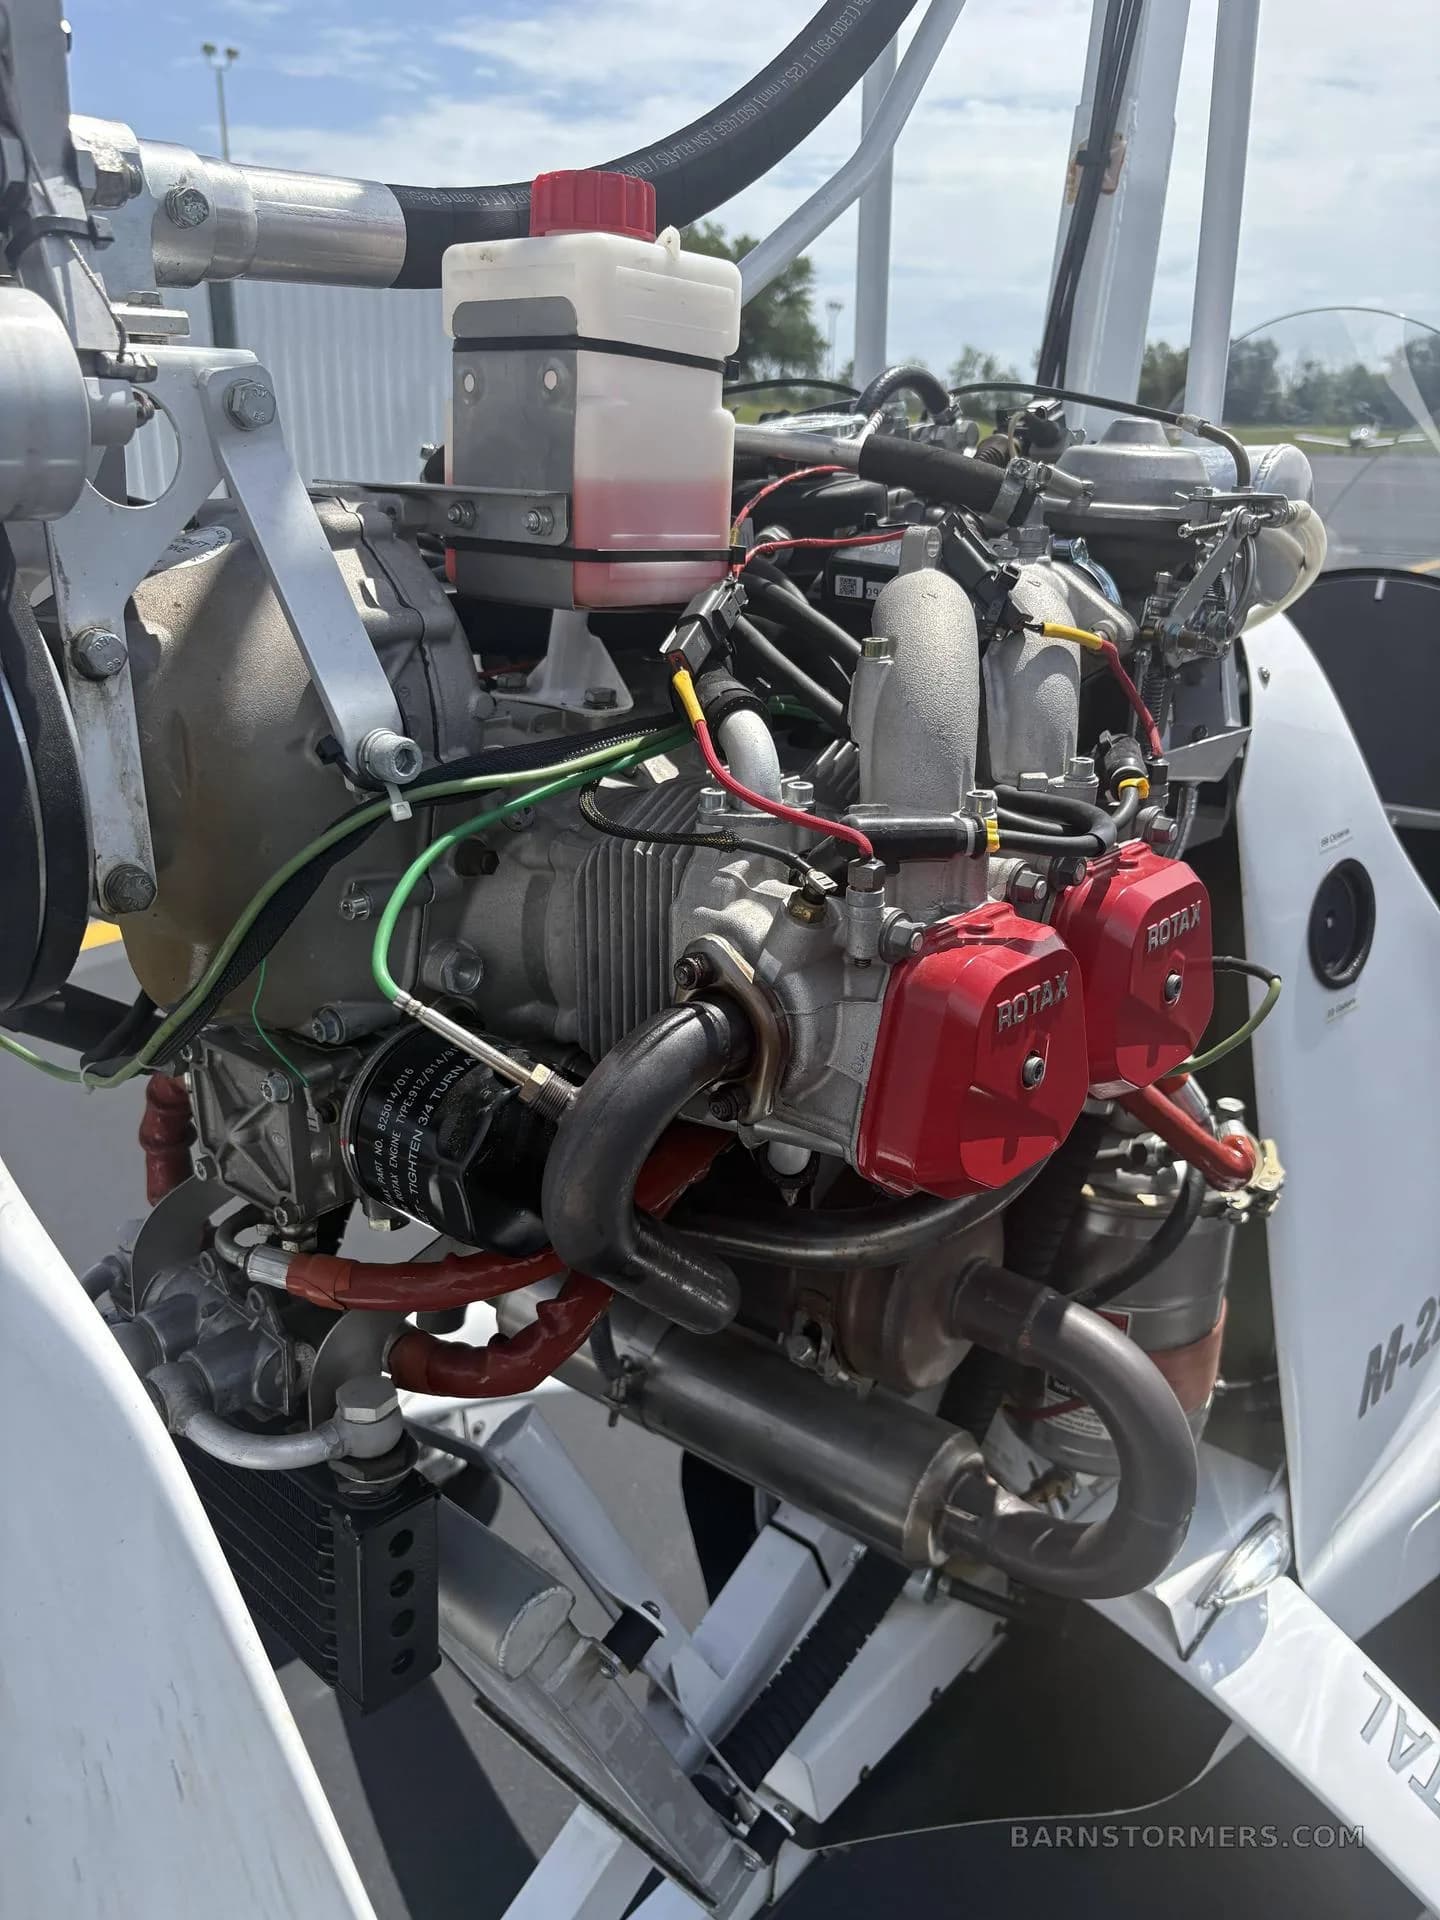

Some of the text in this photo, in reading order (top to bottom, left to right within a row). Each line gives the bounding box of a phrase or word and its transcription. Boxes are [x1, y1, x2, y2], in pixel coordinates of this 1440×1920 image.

[1146, 900, 1202, 953] ROTAX
[996, 971, 1069, 1033] ROTAX
[377, 1067, 415, 1132] 825014/016
[374, 1137, 385, 1157] NO.
[388, 1131, 402, 1169] ENGINE
[406, 1129, 424, 1195] TIGHTEN
[417, 1103, 435, 1127] 3/4
[430, 1064, 465, 1102] TURN
[374, 1160, 386, 1184] PART
